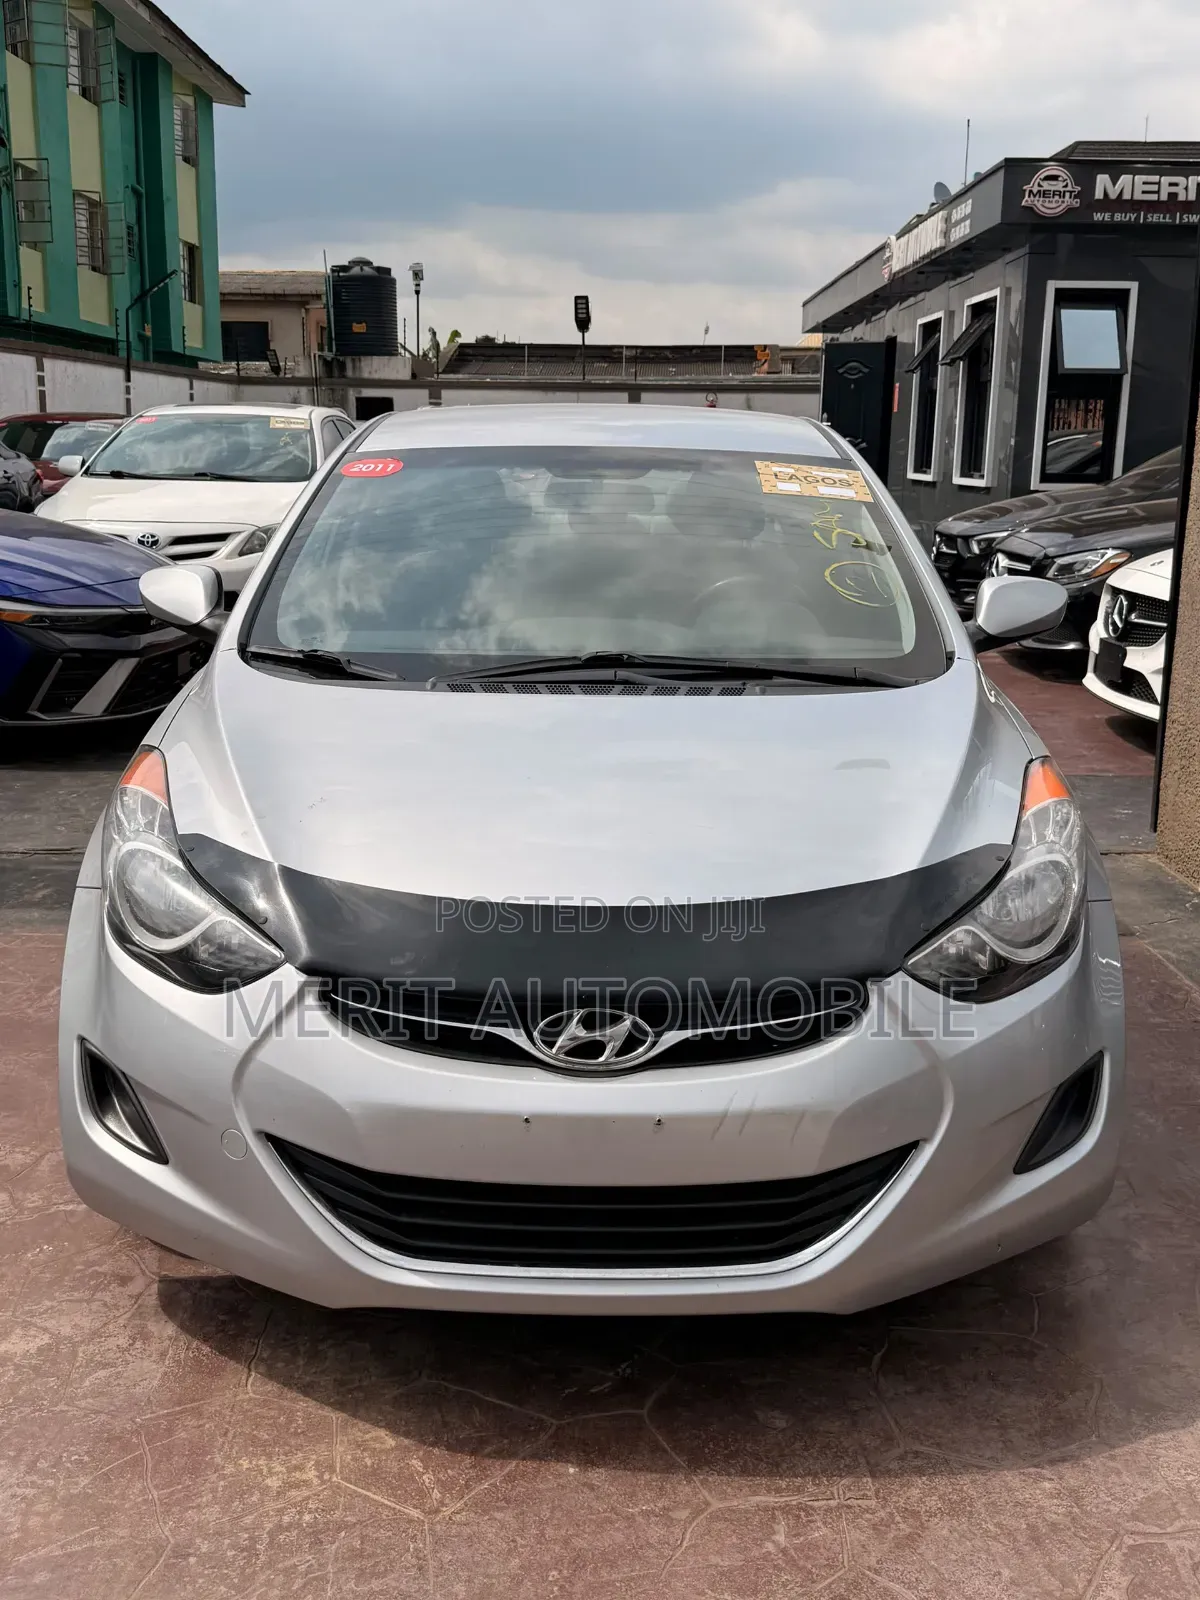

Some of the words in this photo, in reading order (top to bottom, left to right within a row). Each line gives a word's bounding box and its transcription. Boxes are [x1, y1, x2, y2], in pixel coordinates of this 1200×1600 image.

[1094, 174, 1200, 201] MERI
[1028, 190, 1077, 199] MERIT
[1093, 212, 1111, 221] WE
[1113, 212, 1137, 222] BUY
[1146, 213, 1172, 223] SELL
[349, 463, 396, 472] 2011
[774, 471, 856, 487] LAGOS
